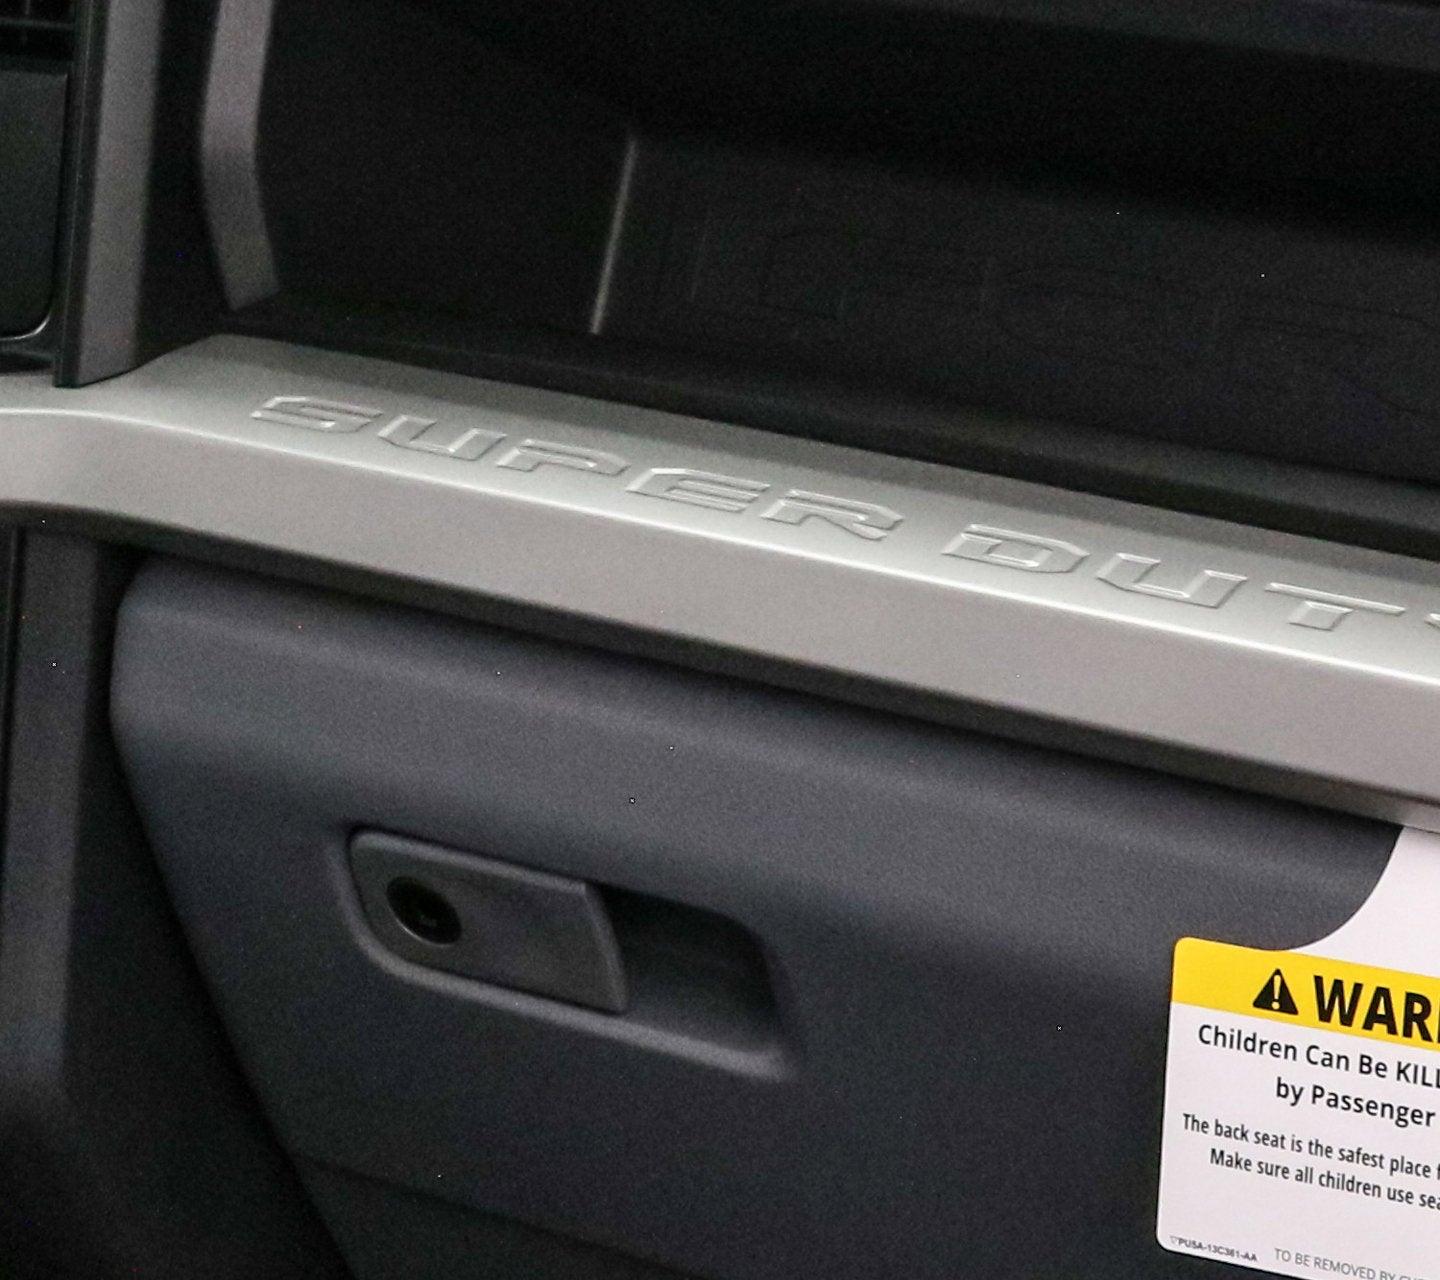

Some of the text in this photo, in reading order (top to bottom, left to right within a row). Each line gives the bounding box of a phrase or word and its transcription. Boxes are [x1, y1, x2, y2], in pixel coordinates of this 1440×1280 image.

[250, 395, 906, 542] SUPER
[1198, 1024, 1297, 1062] Children
[1305, 1044, 1350, 1072] Can
[1358, 1053, 1388, 1079] Be
[1276, 1076, 1305, 1107] by
[1311, 1084, 1436, 1129] Passenger
[1182, 1112, 1210, 1135] The
[1214, 1118, 1249, 1143] back
[1253, 1131, 1286, 1150] seat
[1290, 1134, 1303, 1153] is
[1308, 1138, 1334, 1159] the
[1337, 1146, 1385, 1170] safest
[1389, 1155, 1432, 1179] place
[1210, 1147, 1253, 1172] Make
[1256, 1160, 1290, 1180] sure
[1294, 1165, 1314, 1185] all
[1318, 1170, 1382, 1198] children
[1386, 1187, 1415, 1205] use
[1274, 1247, 1292, 1263] TO
[1294, 1252, 1311, 1268] BE
[1313, 1256, 1377, 1280] REMOVED
